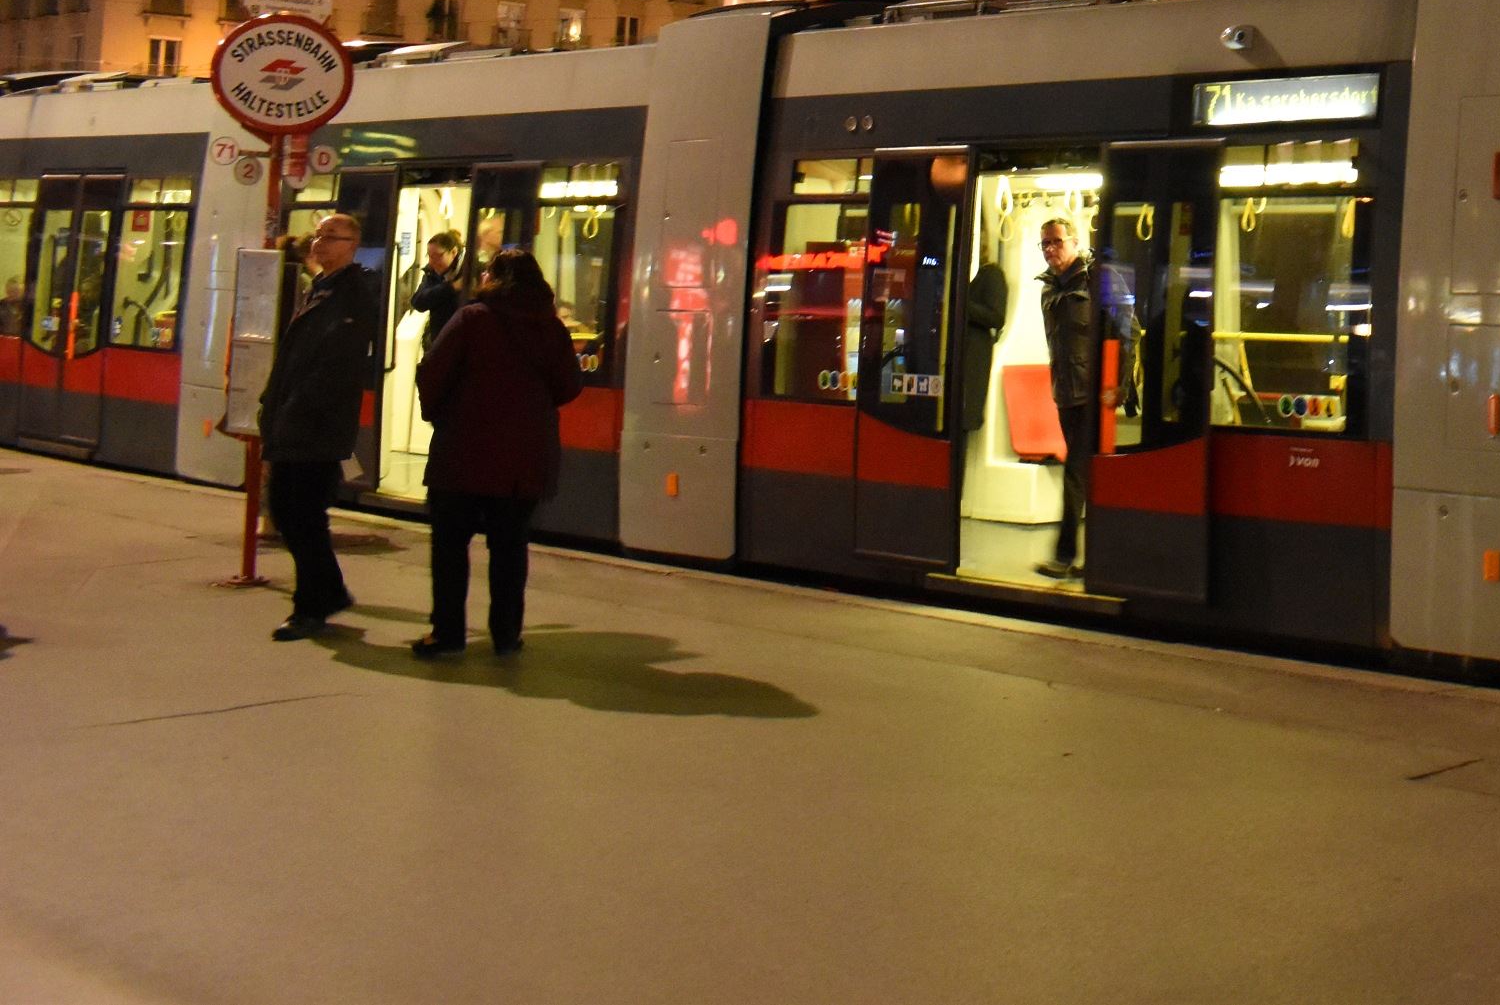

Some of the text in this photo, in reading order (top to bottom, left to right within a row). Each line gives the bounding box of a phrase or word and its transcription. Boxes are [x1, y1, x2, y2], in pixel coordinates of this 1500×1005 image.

[231, 29, 338, 73] STRASSENBAHN
[231, 82, 330, 118] HALTESTELLE
[1206, 84, 1233, 125] 71
[215, 143, 235, 159] 71
[242, 163, 255, 179] 2
